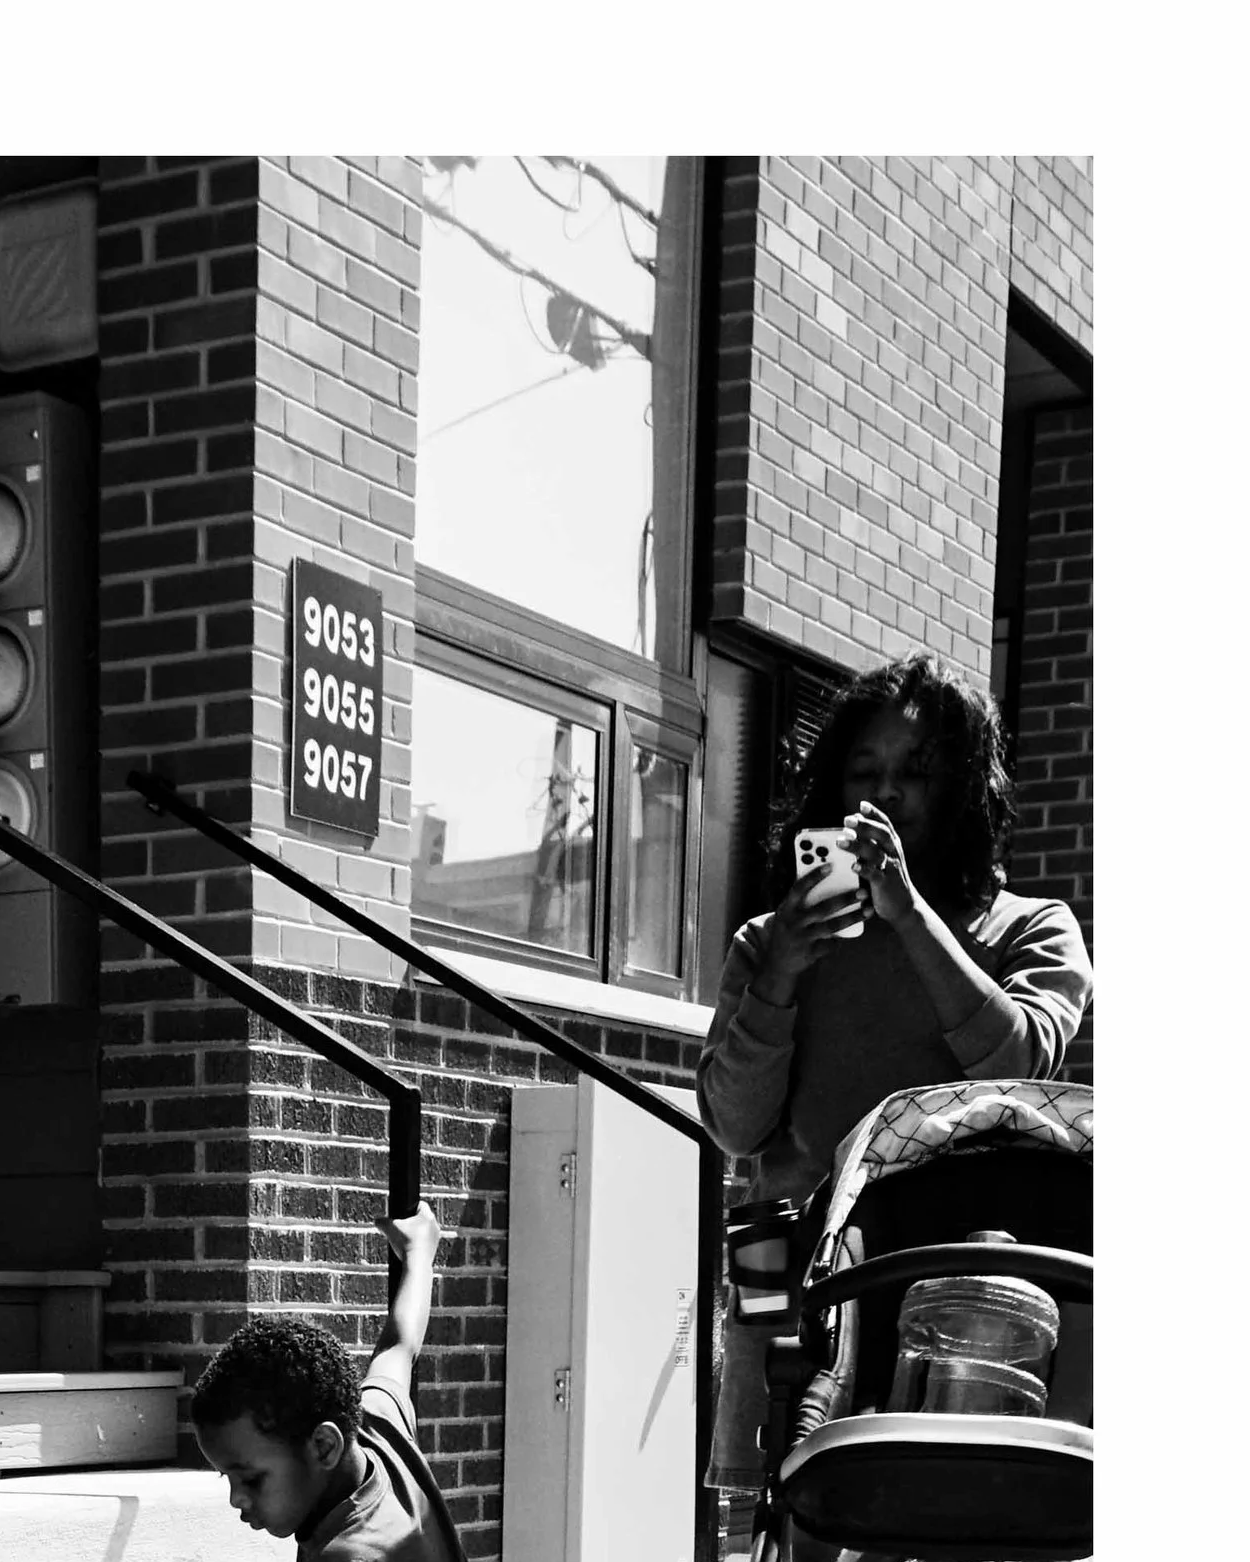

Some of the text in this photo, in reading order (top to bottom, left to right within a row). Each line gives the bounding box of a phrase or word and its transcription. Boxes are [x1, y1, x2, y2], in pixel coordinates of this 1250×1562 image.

[304, 597, 374, 667] 9053
[304, 668, 374, 735] 9055
[304, 738, 372, 800] 9057
